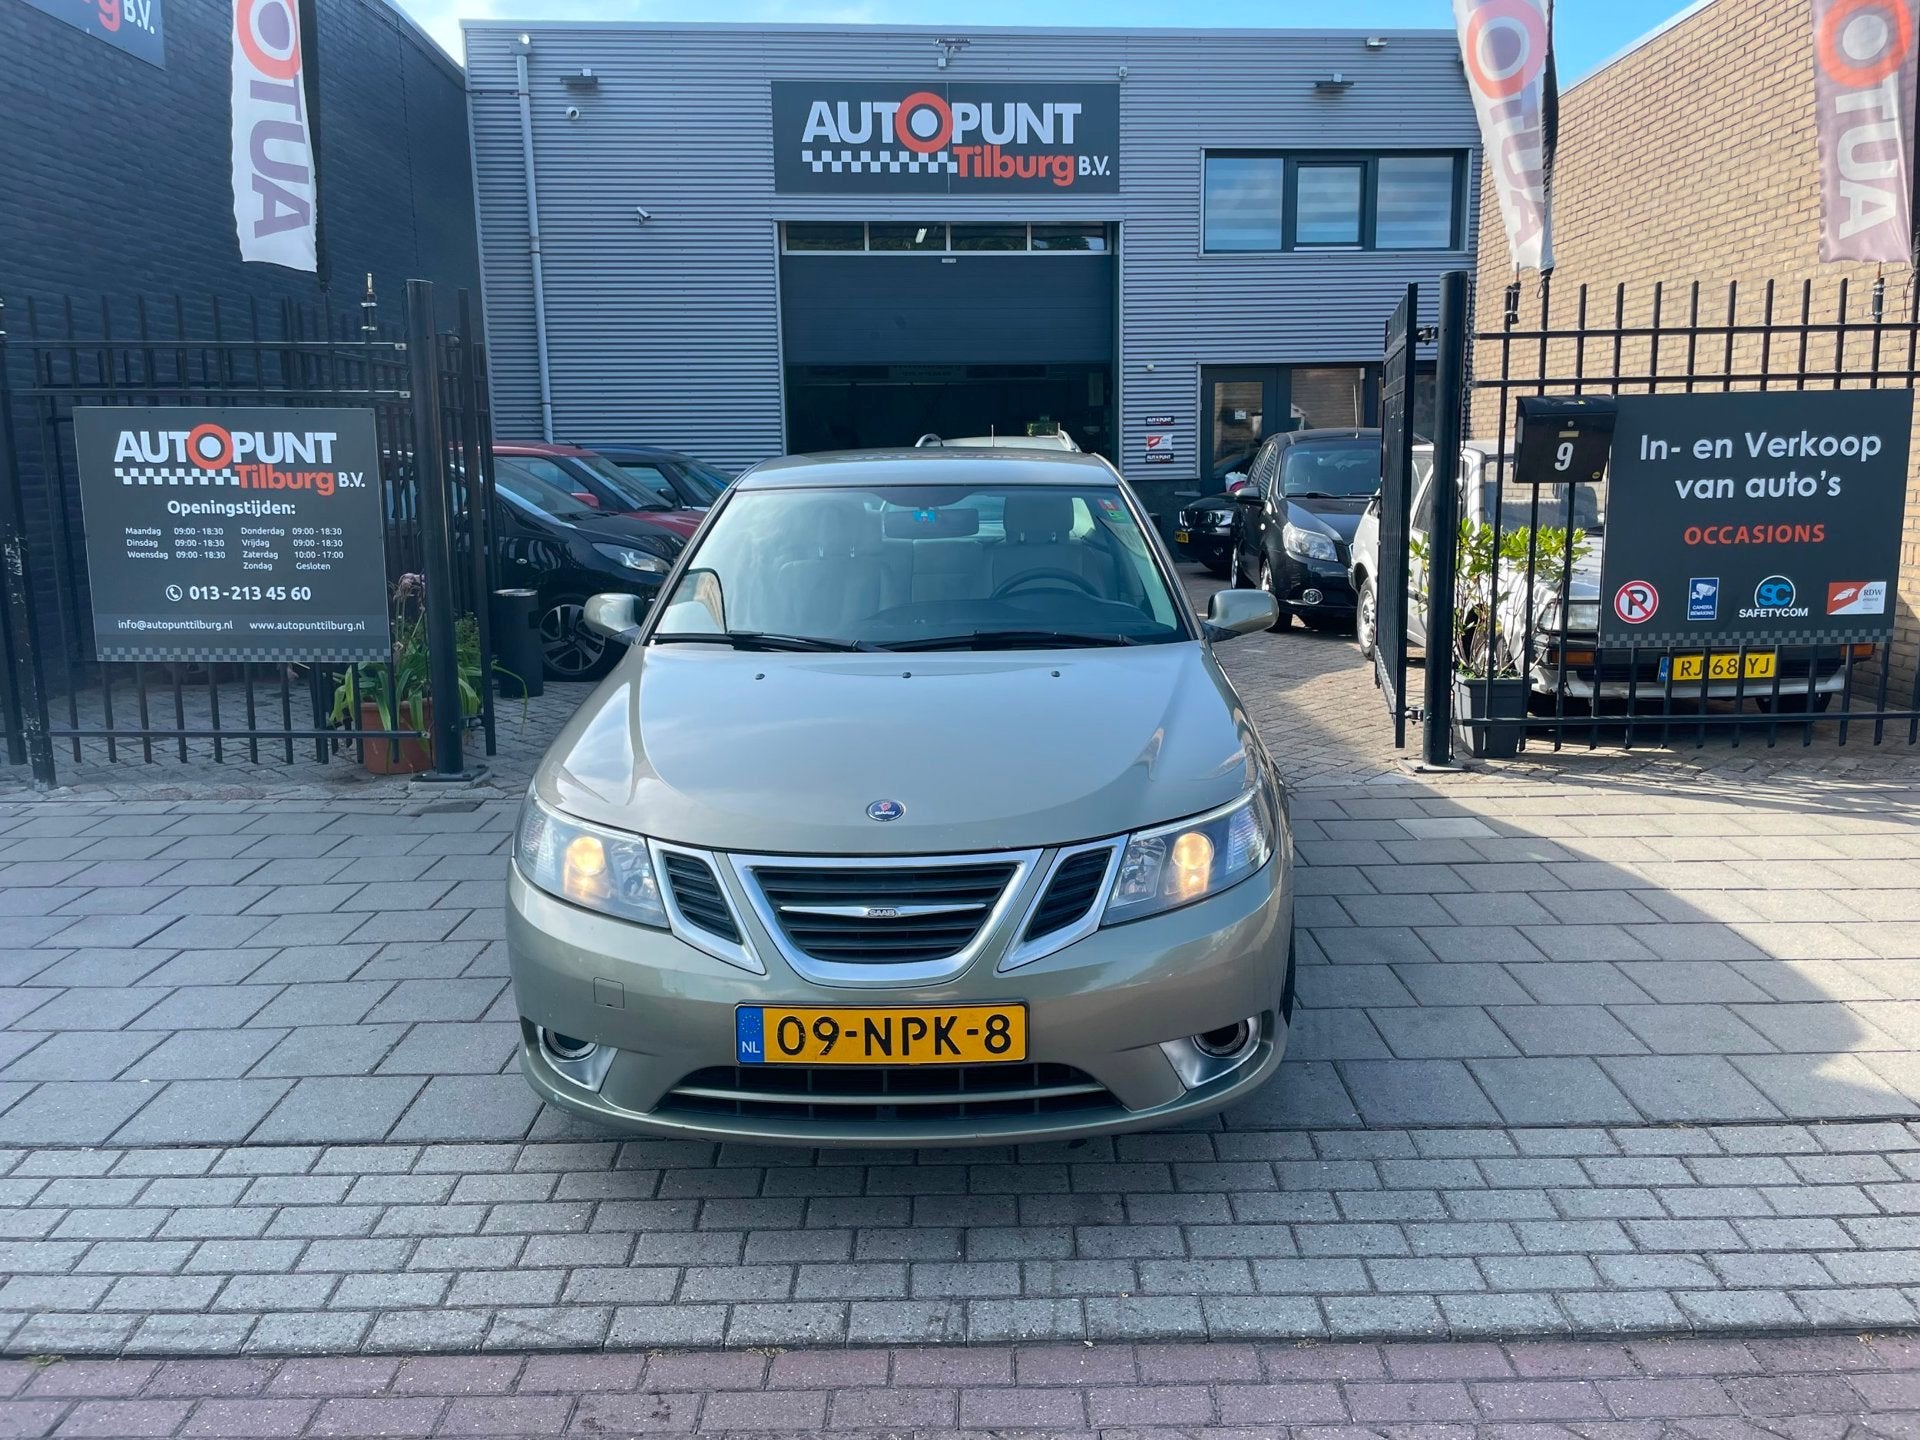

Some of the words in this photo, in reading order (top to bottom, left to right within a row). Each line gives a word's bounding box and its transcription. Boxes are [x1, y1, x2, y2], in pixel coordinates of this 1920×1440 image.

[801, 91, 1082, 153] AUTOPUNT
[953, 144, 1074, 187] Tilburg
[1078, 156, 1111, 176] B.V.
[114, 423, 337, 470] AUTOPUNT
[1640, 434, 1681, 461] In-
[1692, 438, 1732, 459] en
[1744, 430, 1882, 462] Verkoop
[1554, 442, 1574, 471] 9
[234, 463, 334, 496] Tilburg
[338, 471, 366, 488] B.V.
[1674, 477, 1734, 500] van
[1745, 470, 1842, 498] auto's
[167, 500, 296, 517] Openingstijden:
[125, 527, 161, 536] Maandag
[174, 527, 196, 535] 09:00
[241, 527, 285, 536] Donderdag
[292, 527, 314, 535] 09:00
[1683, 524, 1825, 545] OCCASIONS
[126, 539, 158, 548] Dinsdag
[175, 539, 197, 547] 09:00
[203, 539, 225, 547] 18:30
[242, 539, 270, 548] Vrijdag
[293, 539, 315, 547] 09:00
[321, 539, 343, 547] 18:30
[127, 551, 169, 560] Woensdag
[176, 551, 198, 559] 09:00
[204, 551, 226, 559] 18:30
[242, 550, 279, 560] Zaterdag
[294, 551, 316, 559] 10:00
[322, 551, 344, 559] 17:00
[243, 562, 273, 571] Zondag
[296, 562, 331, 570] Gesloten
[265, 586, 287, 601] 45
[290, 586, 311, 601] 60
[1739, 607, 1808, 618] SAFETYCOM
[117, 619, 233, 631] info@autopunttilburg.nl
[249, 621, 365, 632] www.autopunttilburg.nl
[870, 909, 895, 917] SAAB
[777, 1014, 1012, 1056] 09-NPK-8
[741, 1041, 761, 1054] NL
